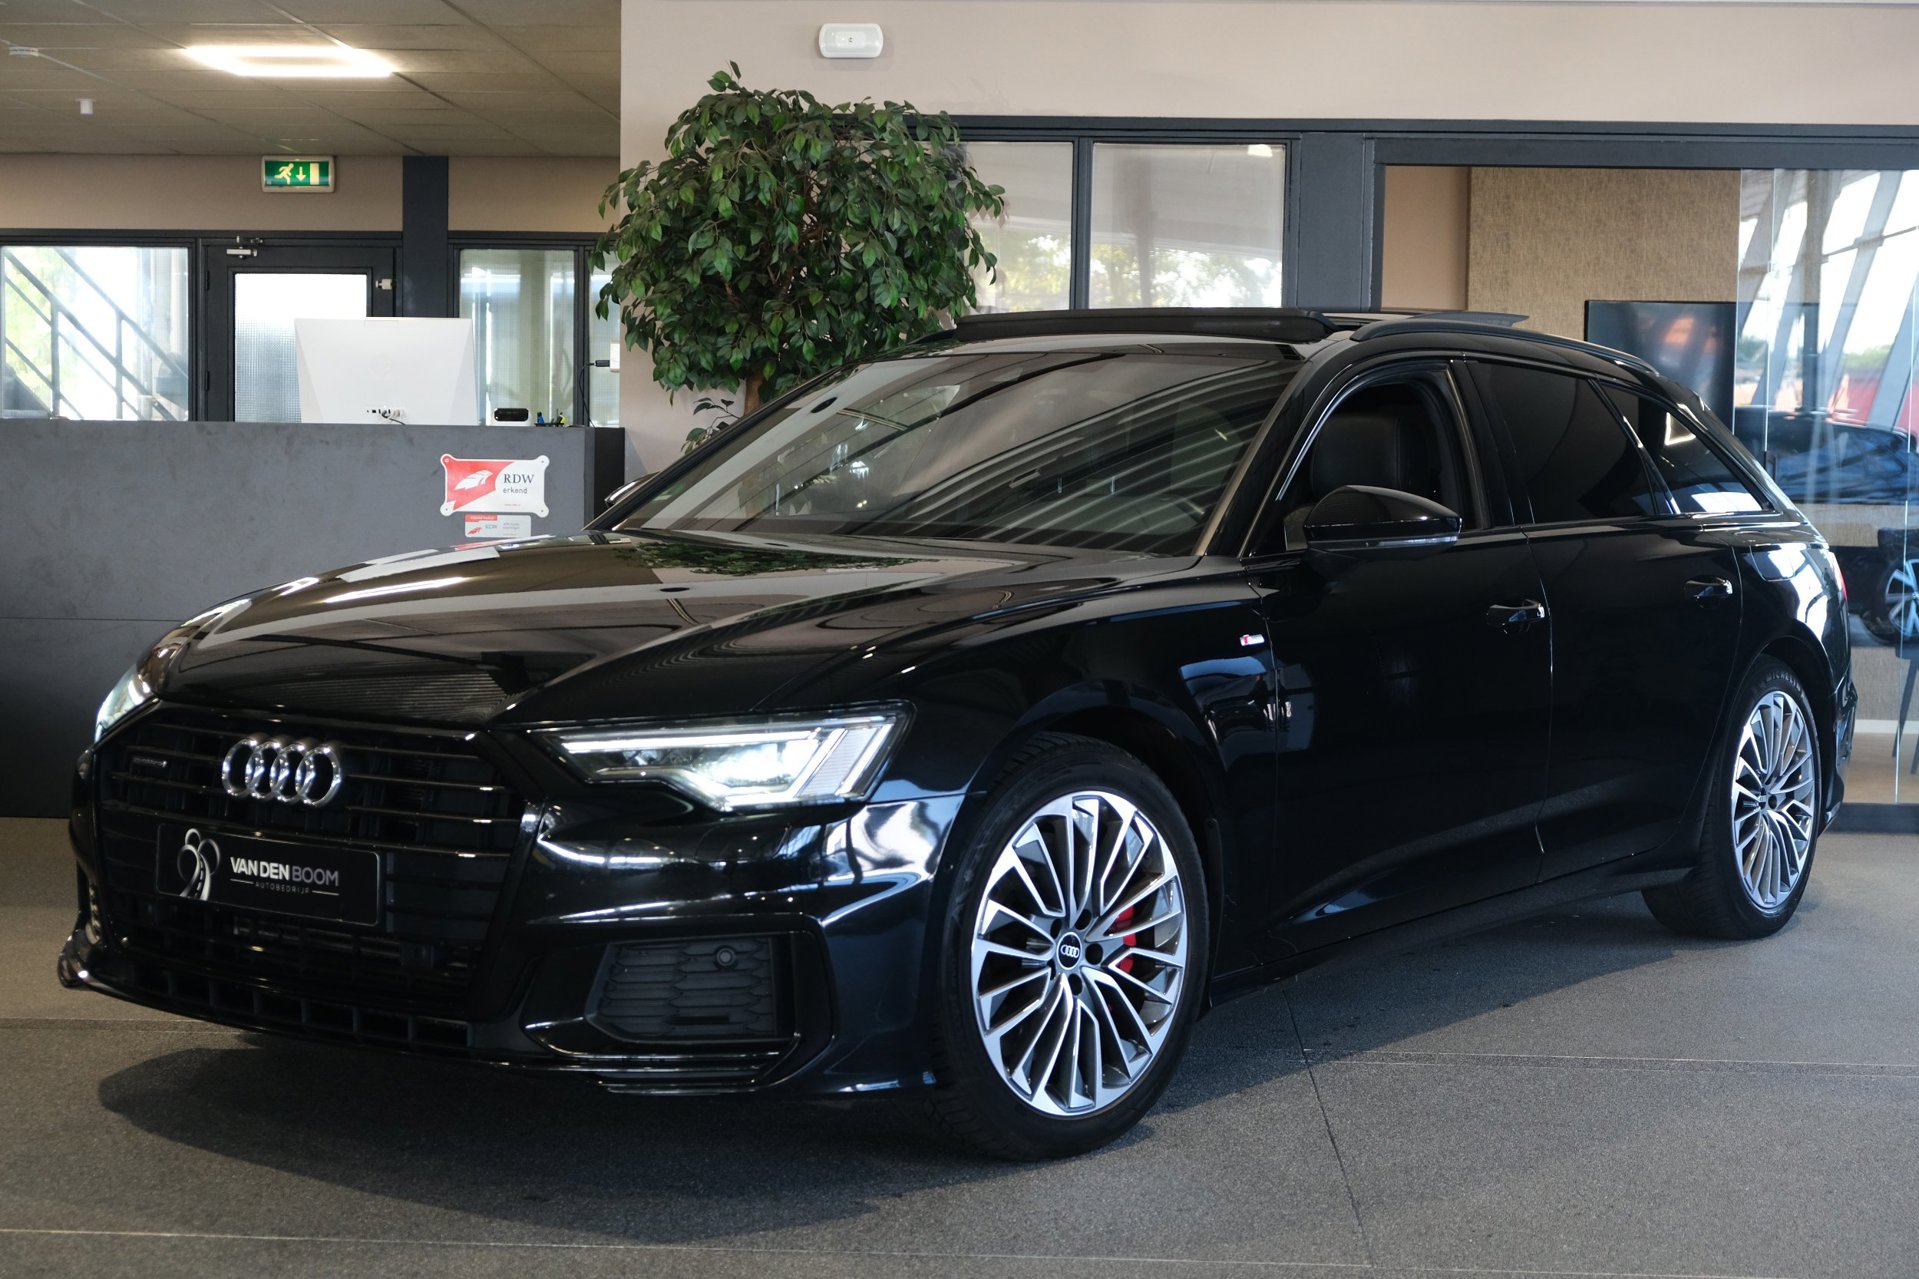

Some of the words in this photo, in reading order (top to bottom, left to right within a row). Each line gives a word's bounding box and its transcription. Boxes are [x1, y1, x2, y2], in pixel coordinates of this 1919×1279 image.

[503, 473, 535, 484] RDW
[229, 856, 258, 877] VAN
[259, 860, 290, 881] DEN
[291, 865, 340, 887] BOOM
